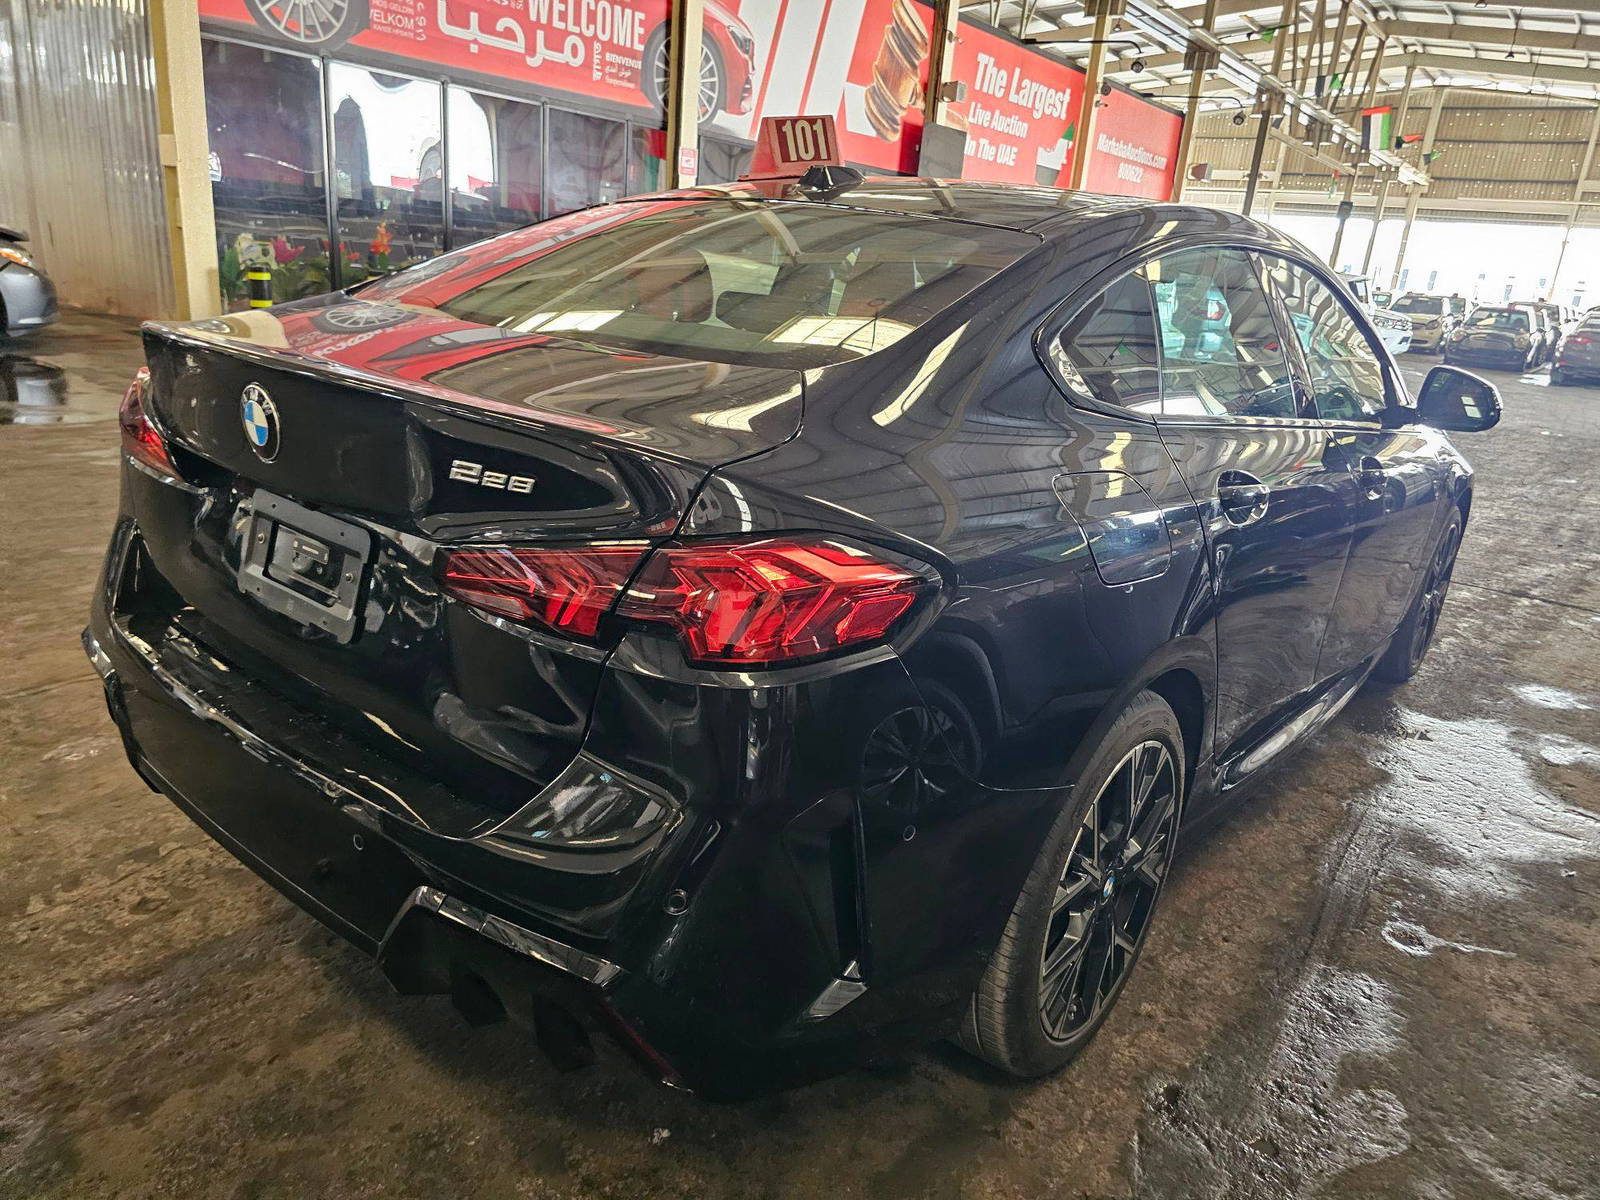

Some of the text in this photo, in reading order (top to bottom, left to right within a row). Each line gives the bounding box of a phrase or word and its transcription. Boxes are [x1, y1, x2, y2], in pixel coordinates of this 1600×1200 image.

[437, 0, 586, 67] مرحبا
[528, 0, 646, 51] WELCOME
[974, 52, 1072, 120] The Largest
[782, 118, 828, 161] 101
[968, 101, 1029, 139] Live Auction
[964, 135, 1019, 167] In The UAE
[449, 459, 536, 494] 228
